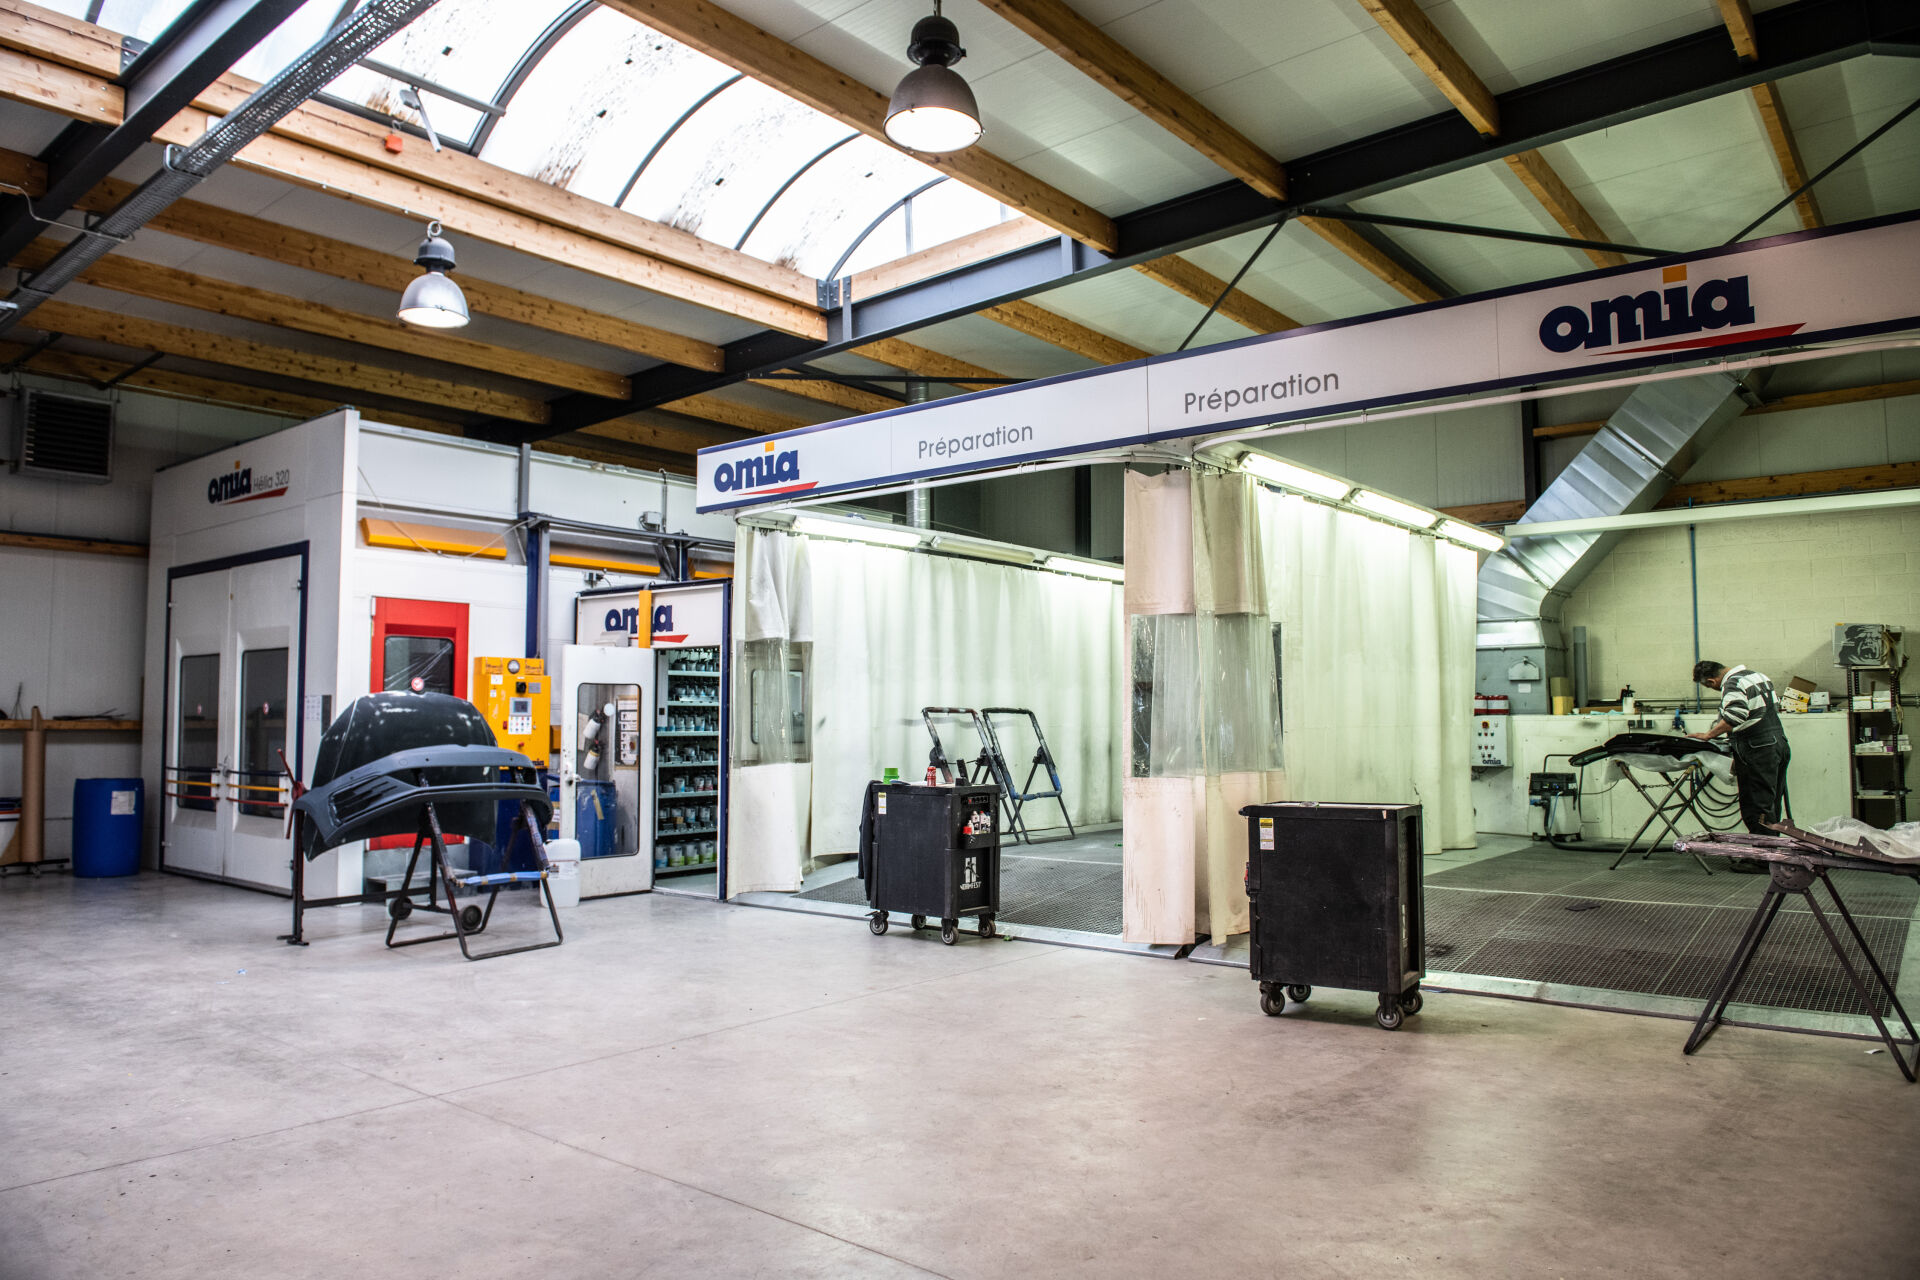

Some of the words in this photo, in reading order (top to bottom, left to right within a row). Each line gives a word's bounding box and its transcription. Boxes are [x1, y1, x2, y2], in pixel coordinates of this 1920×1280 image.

[1539, 265, 1755, 353] omia
[1184, 368, 1340, 413] Préparation
[918, 423, 1033, 459] Préparation
[208, 461, 252, 504] omia
[714, 441, 799, 492] omia
[605, 605, 673, 634] oma
